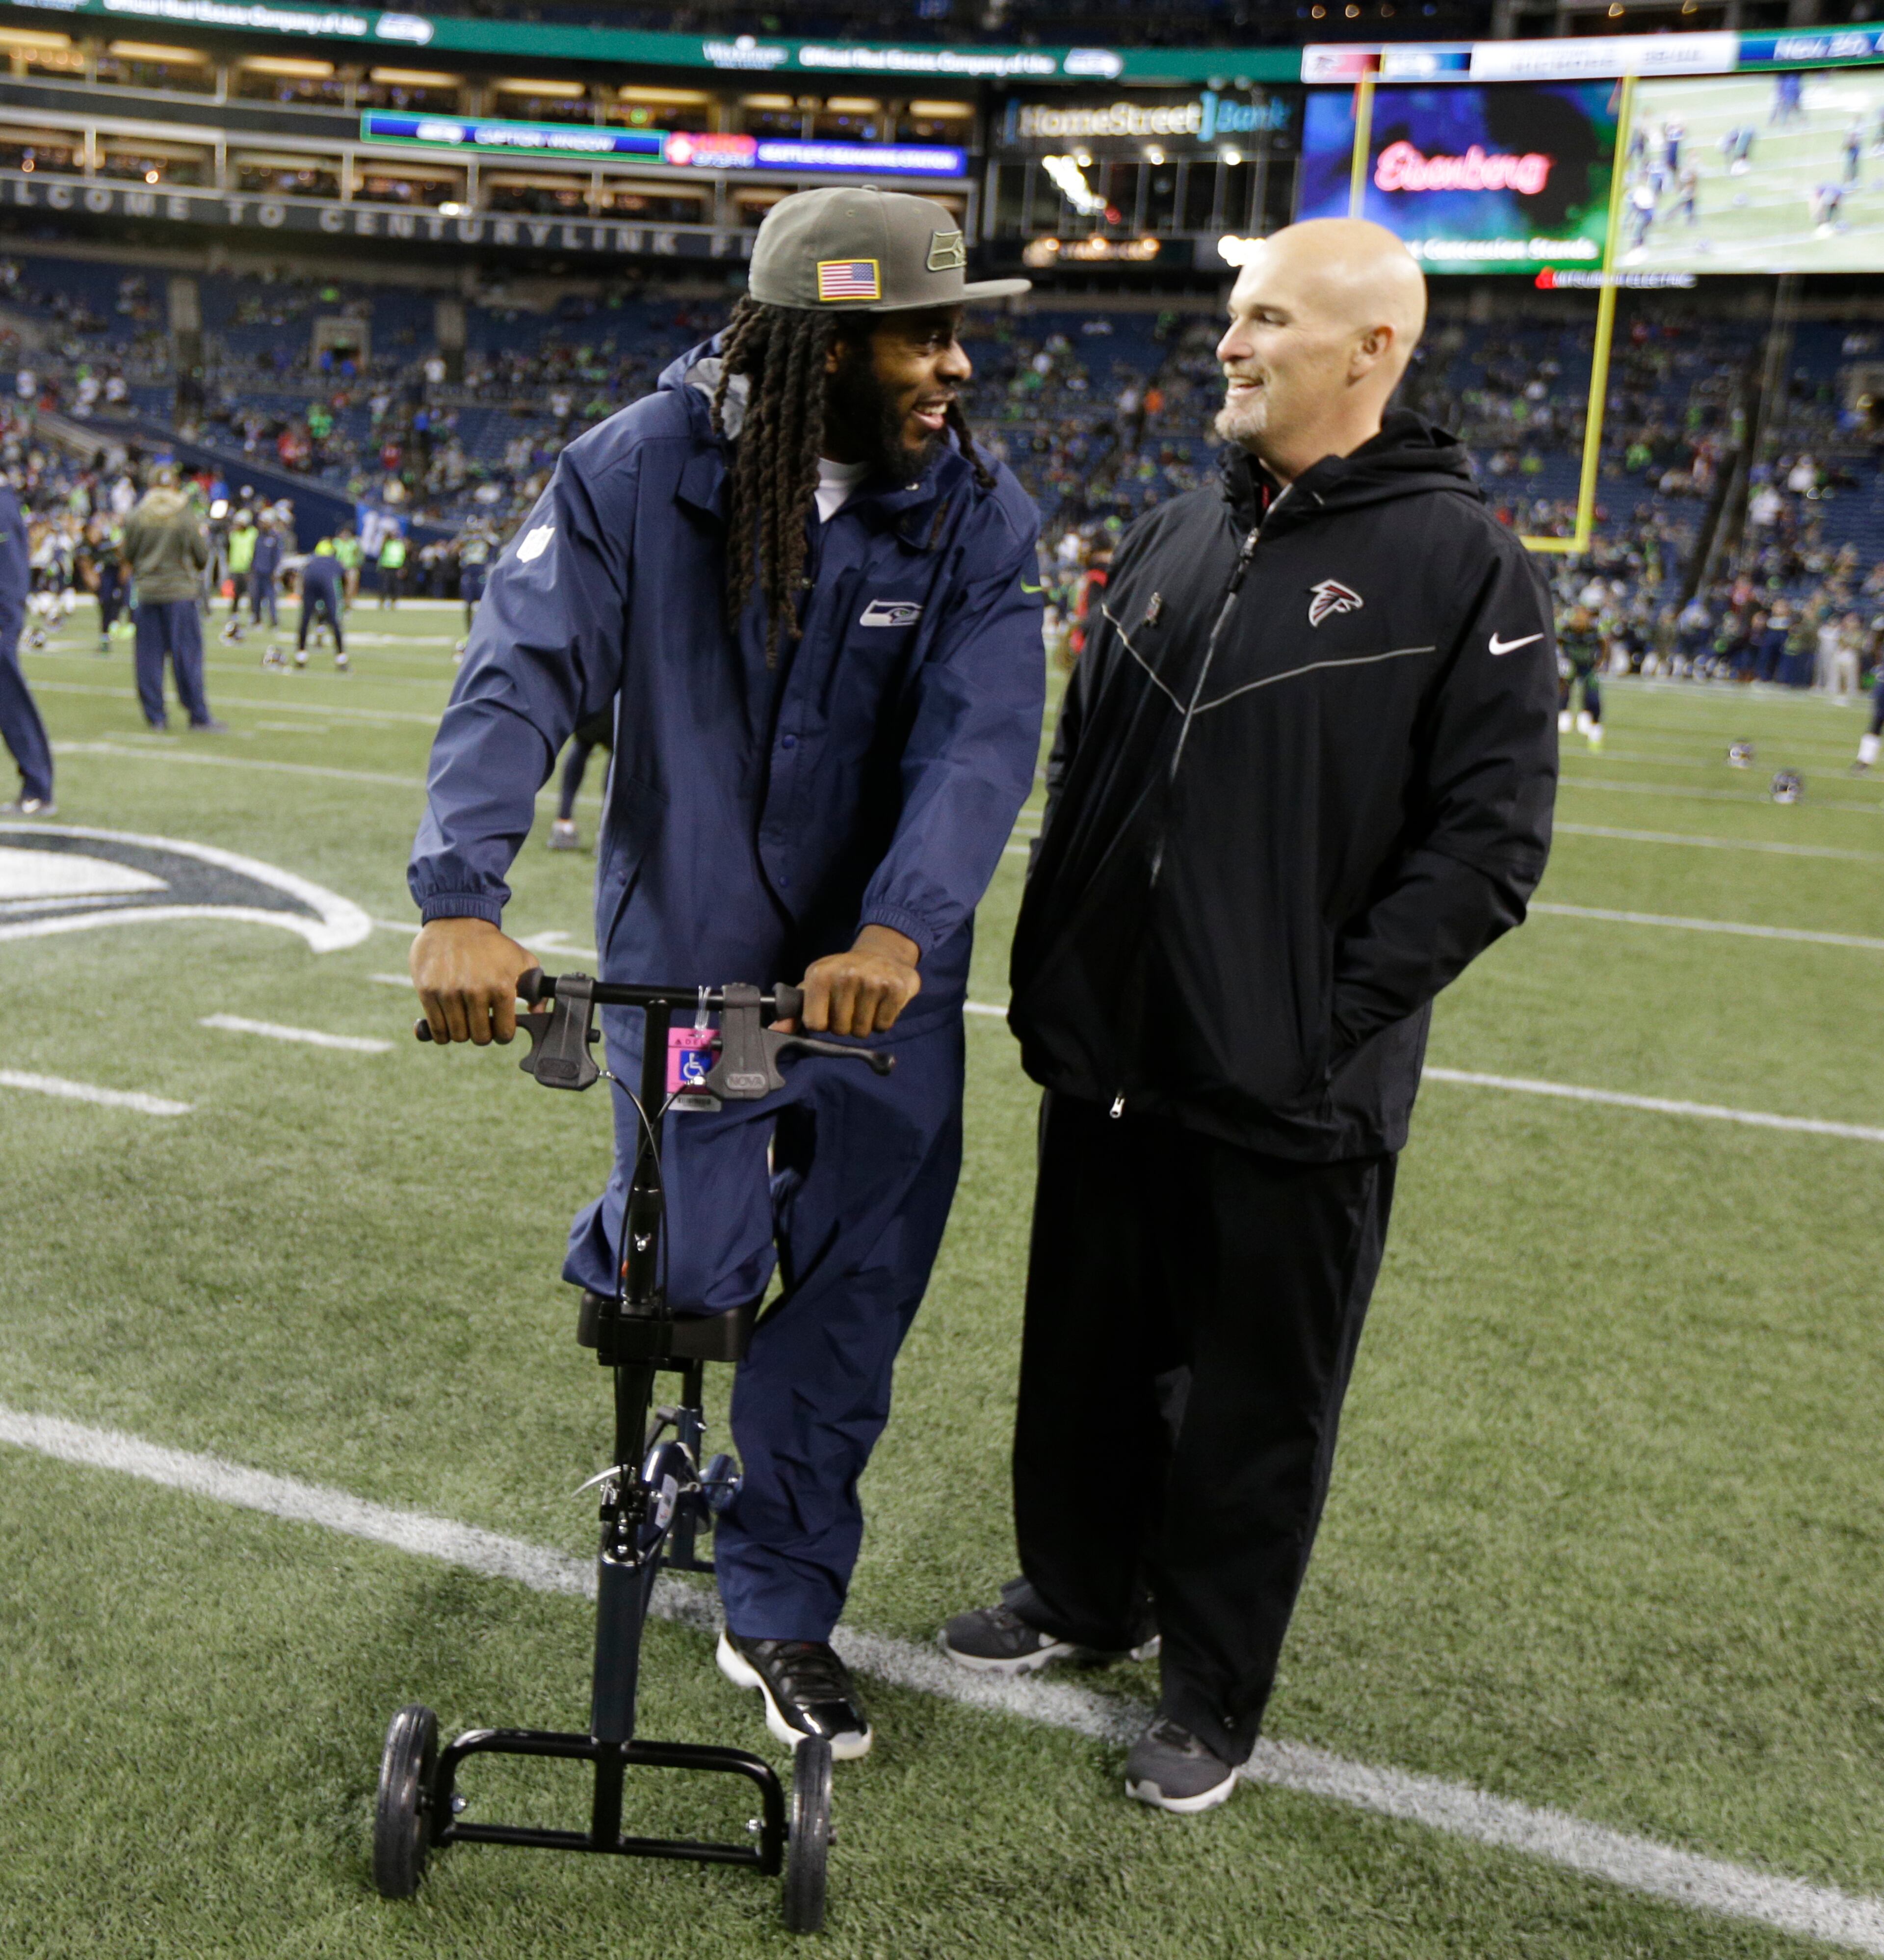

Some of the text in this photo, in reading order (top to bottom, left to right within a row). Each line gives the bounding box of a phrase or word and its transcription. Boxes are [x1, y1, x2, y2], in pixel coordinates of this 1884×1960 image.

[1020, 98, 1289, 137] HomeStreet Bank
[0, 177, 189, 220] LCOME
[225, 200, 286, 228] TO
[319, 208, 679, 254] CENTURYLINK
